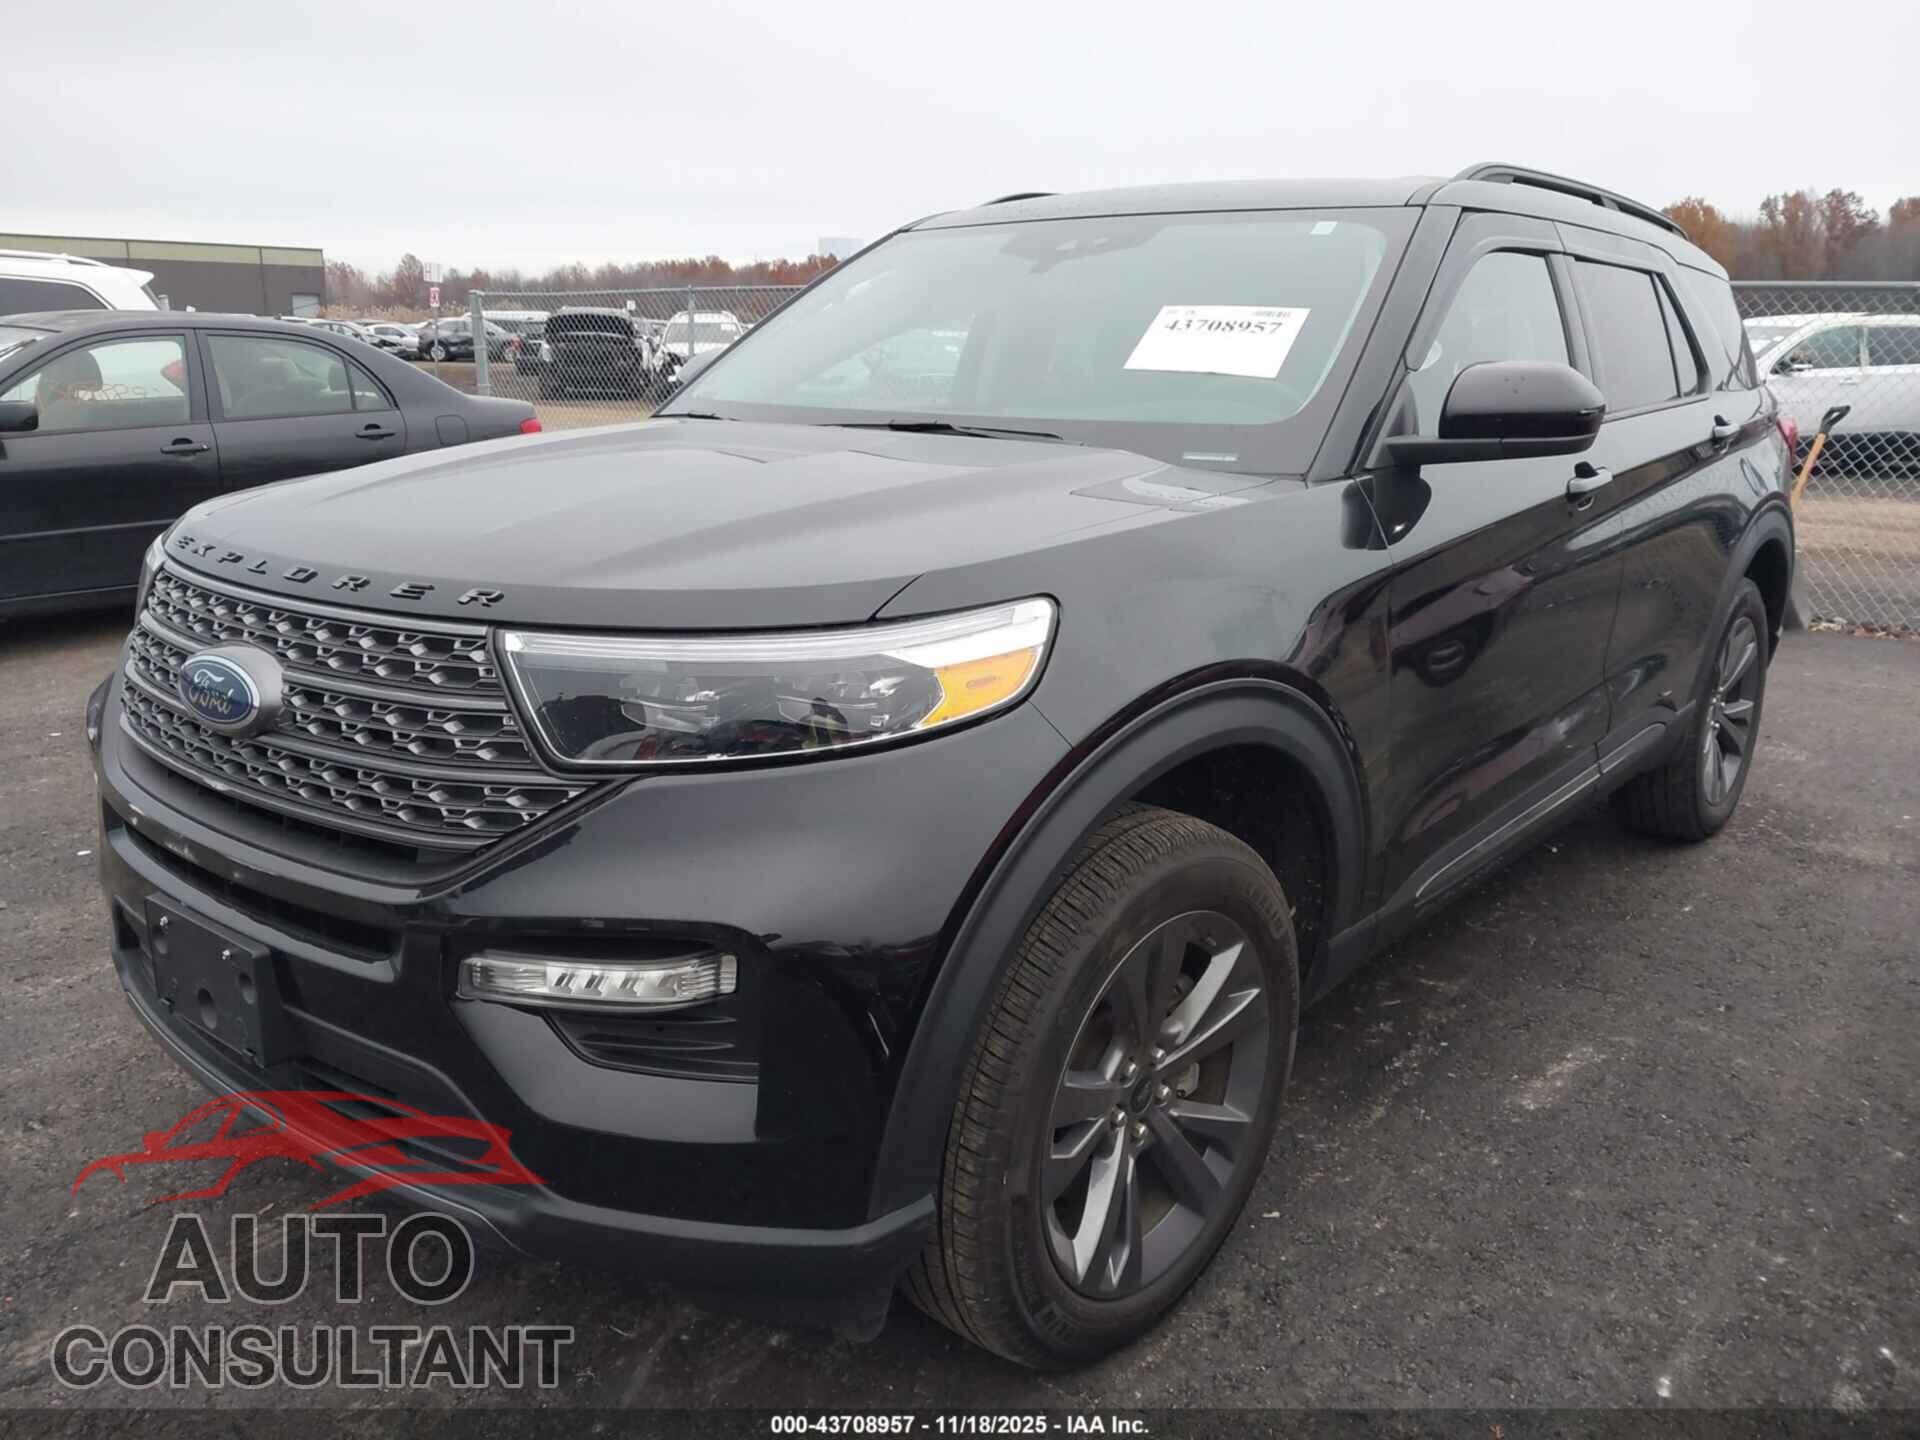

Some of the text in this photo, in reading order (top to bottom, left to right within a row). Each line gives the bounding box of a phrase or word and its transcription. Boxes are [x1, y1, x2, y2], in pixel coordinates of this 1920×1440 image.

[1165, 319, 1283, 335] 43708957
[177, 535, 505, 607] EXPLORER
[188, 668, 235, 715] Ford
